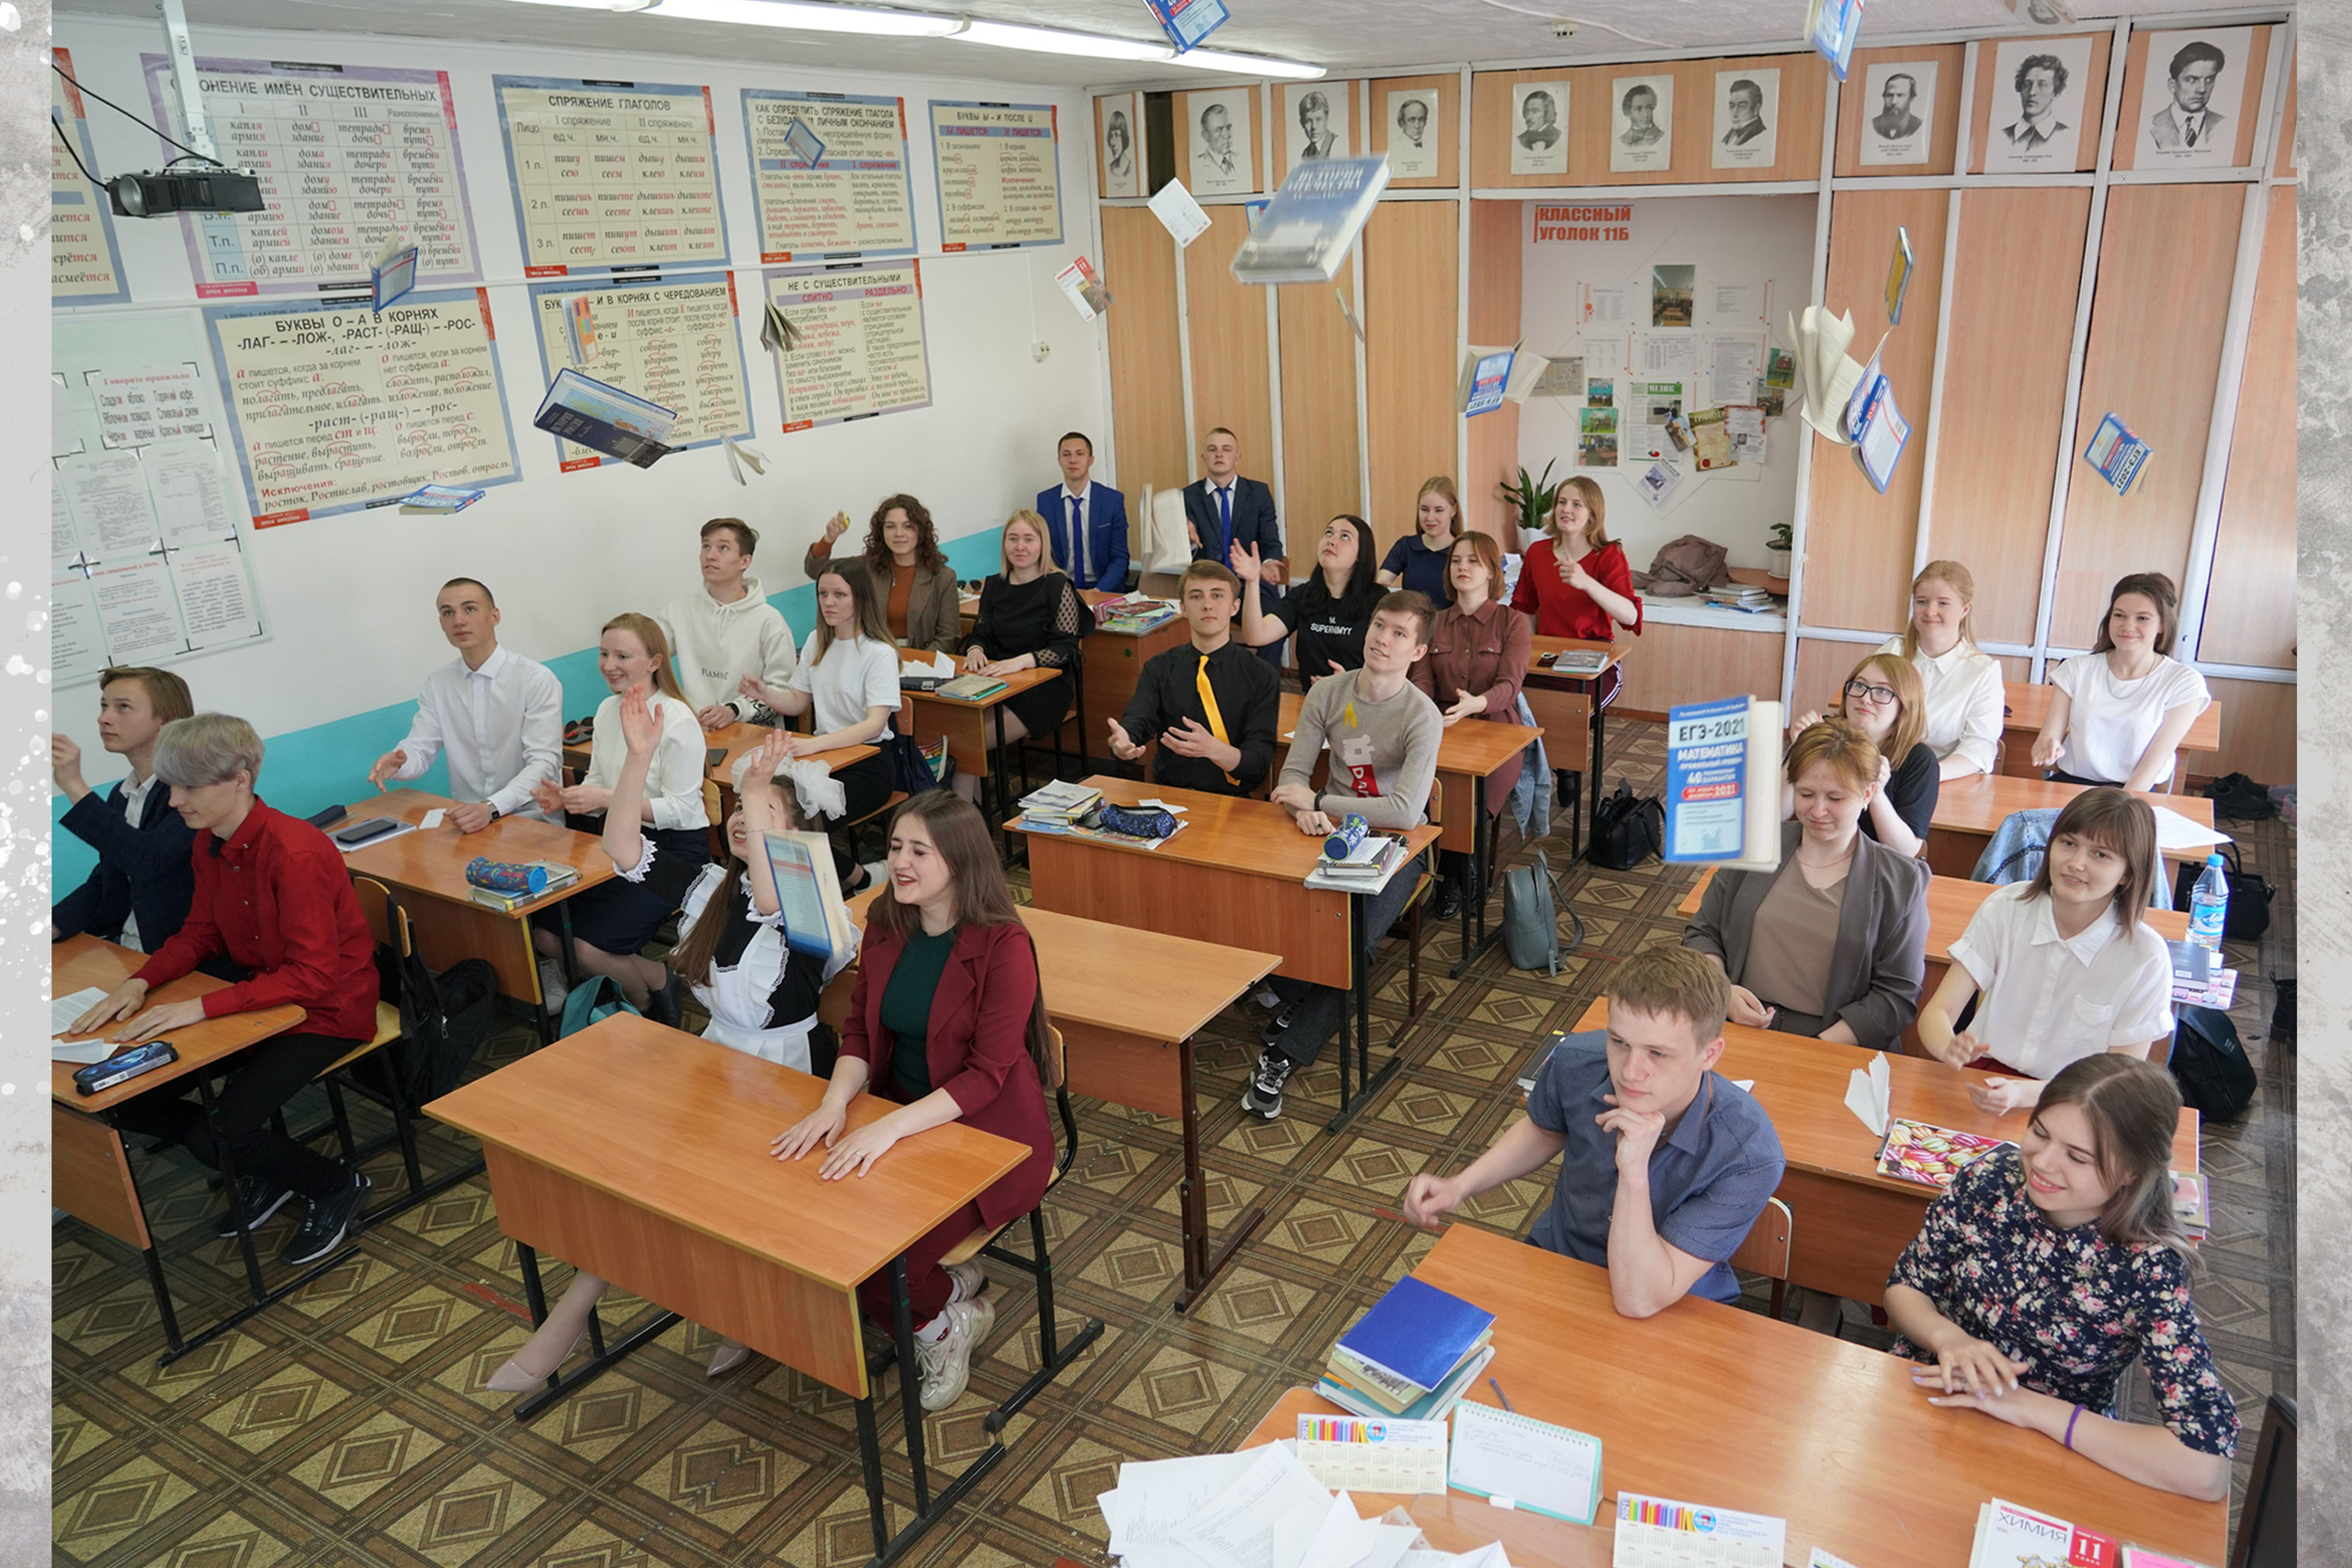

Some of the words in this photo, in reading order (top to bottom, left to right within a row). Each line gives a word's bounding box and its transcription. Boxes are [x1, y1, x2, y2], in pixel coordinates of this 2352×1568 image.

[265, 82, 302, 96] ИМЁН
[309, 84, 436, 102] СУЩЕСТВИТЕЛЬНЫХ
[548, 96, 614, 109] СПРЯЖЕНИЕ
[618, 98, 671, 110] ГЛАГОЛОВ
[354, 107, 368, 118] III
[755, 104, 770, 113] КАК
[773, 105, 819, 116] ОПРЕДЕЛИТЬ
[822, 107, 863, 117] СПРЯЖЕНИЕ
[865, 108, 894, 118] ГЛАГОЛА
[956, 112, 979, 121] БУКВЫ
[1004, 114, 1024, 123] ПОСЛЕ
[230, 121, 262, 130] капля
[403, 123, 431, 137] время
[516, 121, 540, 134] Лицо
[561, 116, 612, 128] спряжение
[648, 118, 694, 130] спряжение
[818, 117, 847, 127] ЛИЧНЫМ
[851, 118, 894, 129] ОКОНЧАНИЕМ
[232, 132, 266, 143] армия
[291, 131, 325, 144] здание
[553, 133, 576, 142] ед.ч.
[236, 149, 268, 158] капли
[299, 148, 324, 161] дома
[346, 148, 390, 162] тетради
[402, 148, 440, 162] времени
[554, 153, 581, 165] пишу
[594, 154, 626, 164] пишем
[639, 152, 664, 165] дышу
[675, 153, 706, 164] дышим
[297, 160, 331, 172] здания
[354, 159, 388, 173] дочери
[411, 162, 435, 172] пути
[304, 175, 329, 187] дому
[351, 173, 395, 186] тетради
[560, 169, 579, 178] сею
[602, 170, 623, 179] сеем
[642, 170, 665, 178] клею
[680, 170, 705, 178] клеим
[359, 186, 391, 197] дочери
[415, 186, 439, 197] пути
[554, 192, 593, 202] пишешь
[598, 192, 634, 201] пишете
[637, 190, 675, 202] дышишь
[677, 190, 712, 200] дышите
[416, 197, 443, 210] время
[248, 212, 285, 224] армию
[309, 211, 341, 222] здание
[562, 208, 590, 217] сеешь
[642, 207, 675, 216] клеишь
[1539, 205, 1632, 222] КЛАССНЫЙ
[251, 226, 288, 237] каплей
[311, 224, 344, 236] домом
[562, 231, 595, 241] пишет
[605, 230, 638, 242] пишут
[644, 227, 678, 238] дышит
[684, 226, 715, 236] дышат
[1539, 226, 1600, 242] УГОЛОК
[1603, 227, 1630, 242] 11Б
[209, 236, 234, 247] Т.п.
[253, 236, 290, 250] армией
[309, 234, 349, 247] зданием
[611, 244, 636, 254] сеют
[650, 242, 677, 252] клеит
[688, 241, 715, 251] клеят
[268, 254, 299, 264] капле
[329, 249, 353, 262] доме
[216, 263, 243, 274] П.п.
[272, 265, 305, 277] армии
[326, 263, 359, 275] здании
[436, 258, 459, 269] пути
[788, 281, 799, 291] НЕ
[804, 280, 809, 289] С
[814, 274, 901, 289] СУЩЕСТВИТЕЛЬНЫМИ
[617, 291, 650, 303] КОРНЯХ
[663, 288, 726, 300] ЧЕРЕДОВАНИЕМ
[802, 292, 833, 303] СЛИТНО
[865, 287, 907, 297] РАЗДЕЛЬНО
[276, 317, 325, 333] БУКВЫ
[333, 315, 342, 328] О
[358, 314, 367, 325] А
[373, 313, 382, 324] В
[389, 308, 439, 323] КОРНЯХ
[237, 336, 276, 350] -ЛАГ-
[342, 326, 382, 340] -РАСТ-
[386, 322, 430, 339] (-РАЩ-)
[444, 318, 476, 331] -РОС-
[326, 344, 360, 355] -лаг-
[378, 339, 416, 351] -лож-
[460, 345, 487, 356] корнем
[249, 366, 291, 378] пишется,
[293, 363, 317, 373] когда
[330, 359, 361, 370] корнем
[400, 361, 439, 375] суффикса
[239, 380, 265, 390] стоит
[267, 375, 309, 389] суффикс
[309, 415, 356, 433] -раст-
[426, 401, 458, 416] -рос-
[406, 417, 440, 429] пишется
[442, 413, 466, 423] перед
[265, 436, 303, 449] пишется
[306, 434, 333, 444] перед
[2116, 448, 2142, 490] ЕГЭ-2021
[262, 479, 337, 498] Исключения:
[1679, 717, 1745, 741] ЕГЭ-2021
[1677, 742, 1744, 762] МАТЕМАТИКА
[1714, 784, 1736, 796] 2021
[1997, 1511, 2068, 1544] ХИМИЯ
[2078, 1539, 2101, 1561] 11
